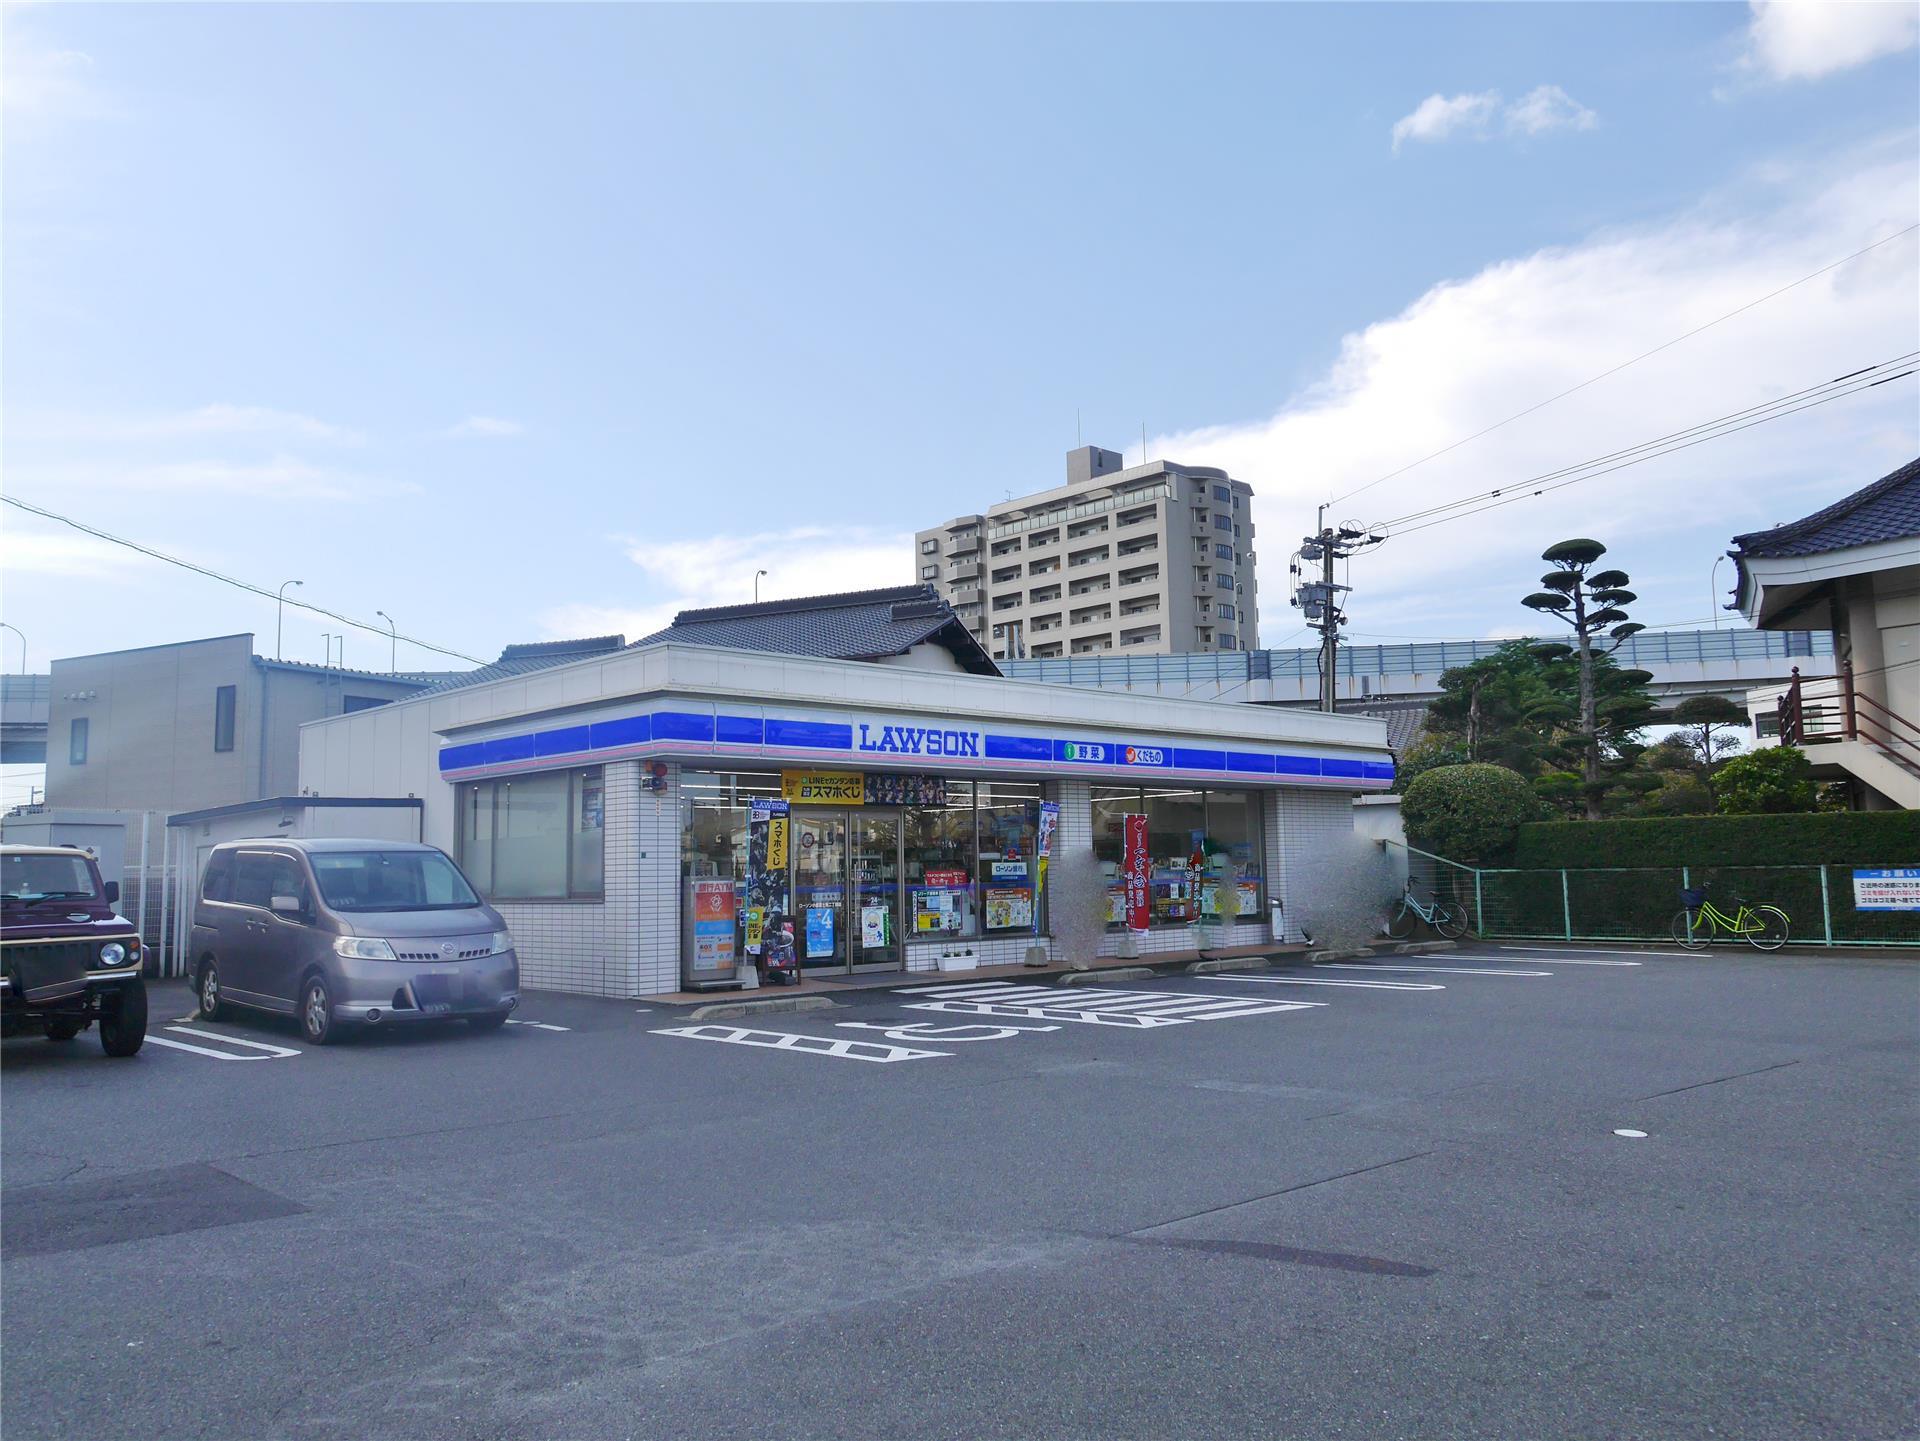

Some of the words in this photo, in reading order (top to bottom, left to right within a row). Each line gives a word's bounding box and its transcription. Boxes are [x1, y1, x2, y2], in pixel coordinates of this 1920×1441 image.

[859, 724, 980, 758] LAWSON
[1077, 745, 1101, 760] 野菜
[1136, 749, 1162, 764] くだもの
[813, 785, 861, 799] スマホくじ
[753, 801, 788, 811] LAWSON
[772, 821, 783, 866] スマホくじ
[995, 864, 1023, 873] ローソン銀行
